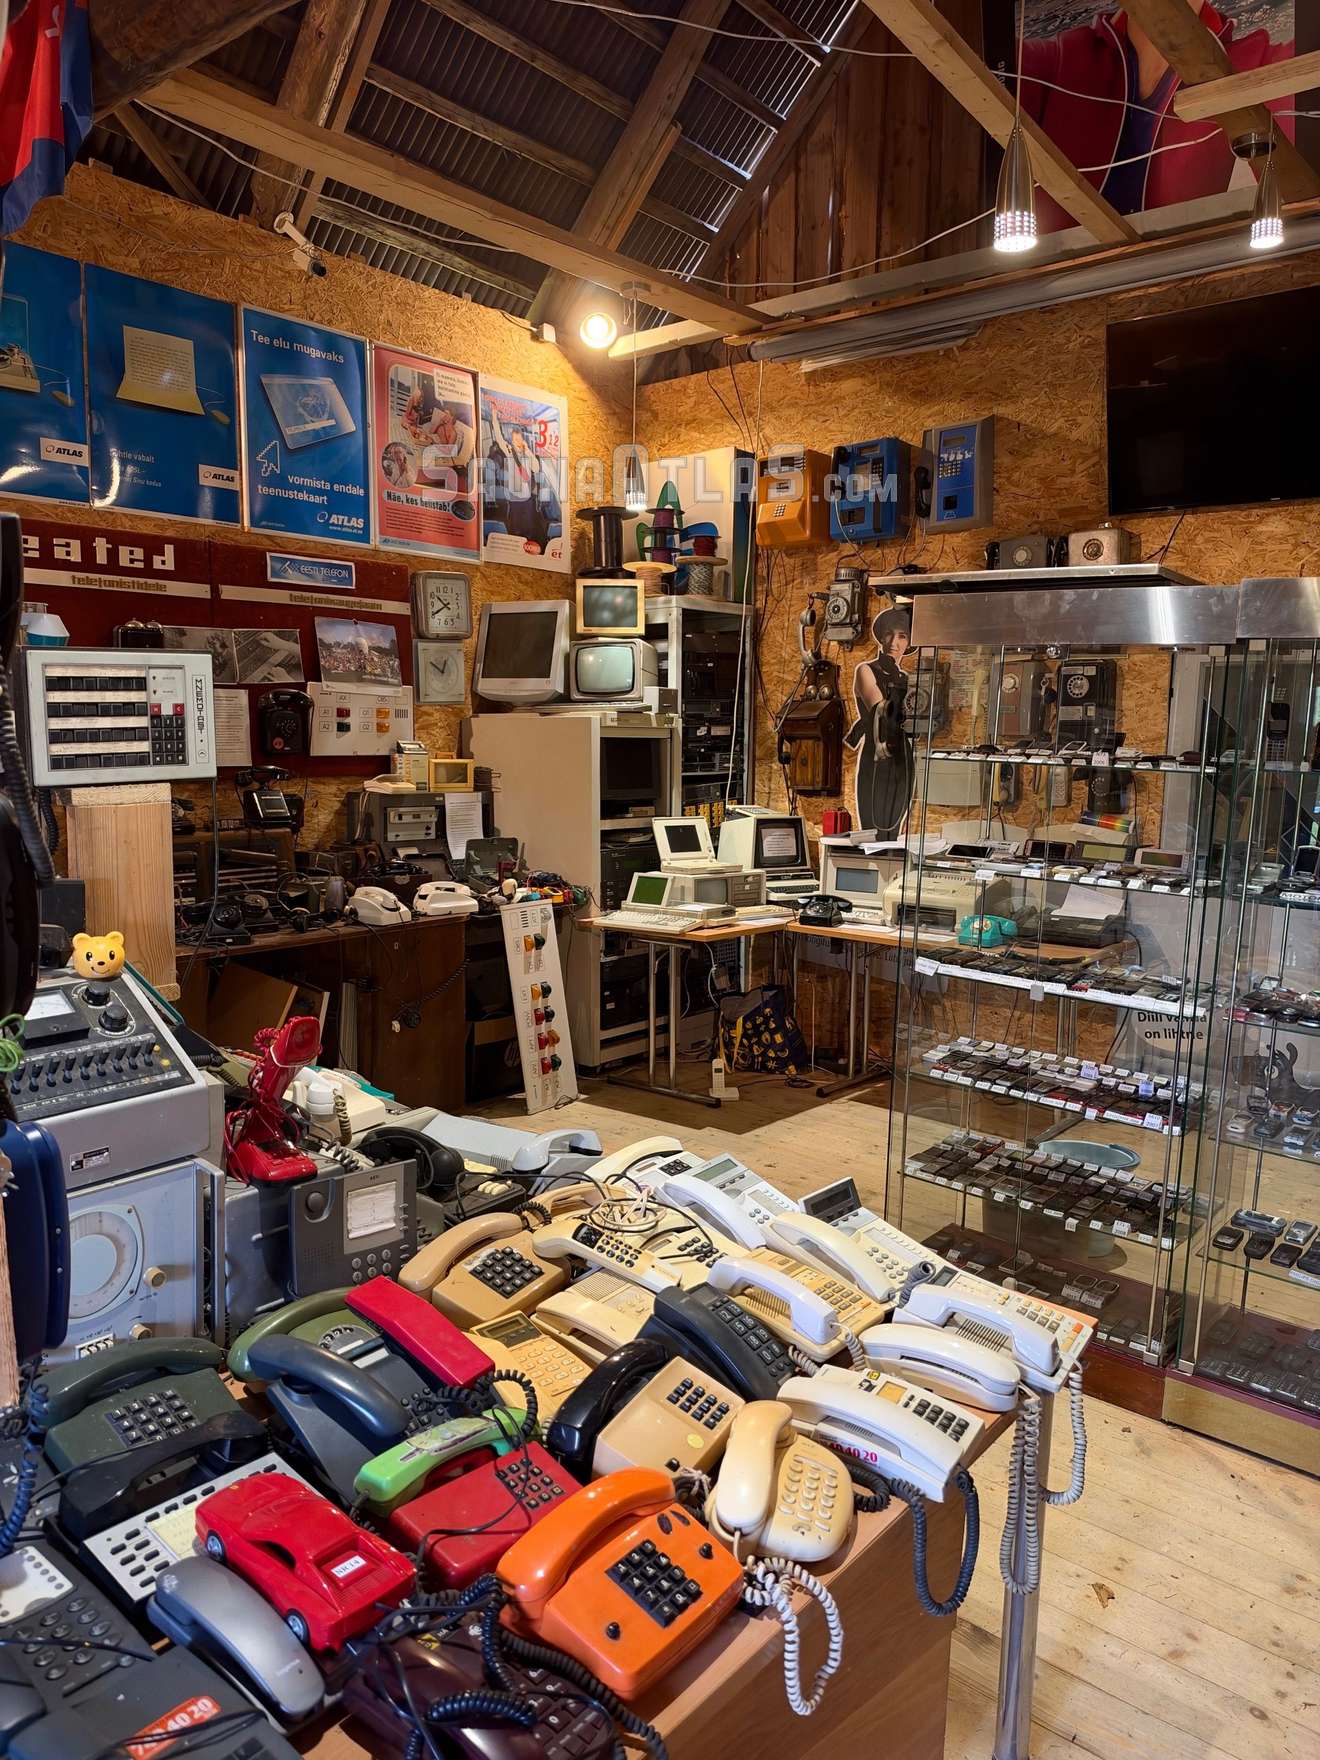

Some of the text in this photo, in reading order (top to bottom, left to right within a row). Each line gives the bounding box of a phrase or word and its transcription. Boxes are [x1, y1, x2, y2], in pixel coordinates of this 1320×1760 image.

[251, 329, 344, 364] Tee elu mugavaks
[55, 446, 83, 458] ATLAS
[211, 473, 236, 483] ATLAS
[288, 475, 365, 496] vormista endale
[257, 484, 328, 505] teenustekaart
[405, 494, 419, 506] kes
[328, 513, 364, 529] ATLAS
[300, 565, 349, 578] EESTI TELEFON
[71, 574, 167, 593] telefonistidele
[1144, 1030, 1161, 1039] on
[863, 1451, 878, 1463] 20
[187, 1699, 212, 1719] 20
